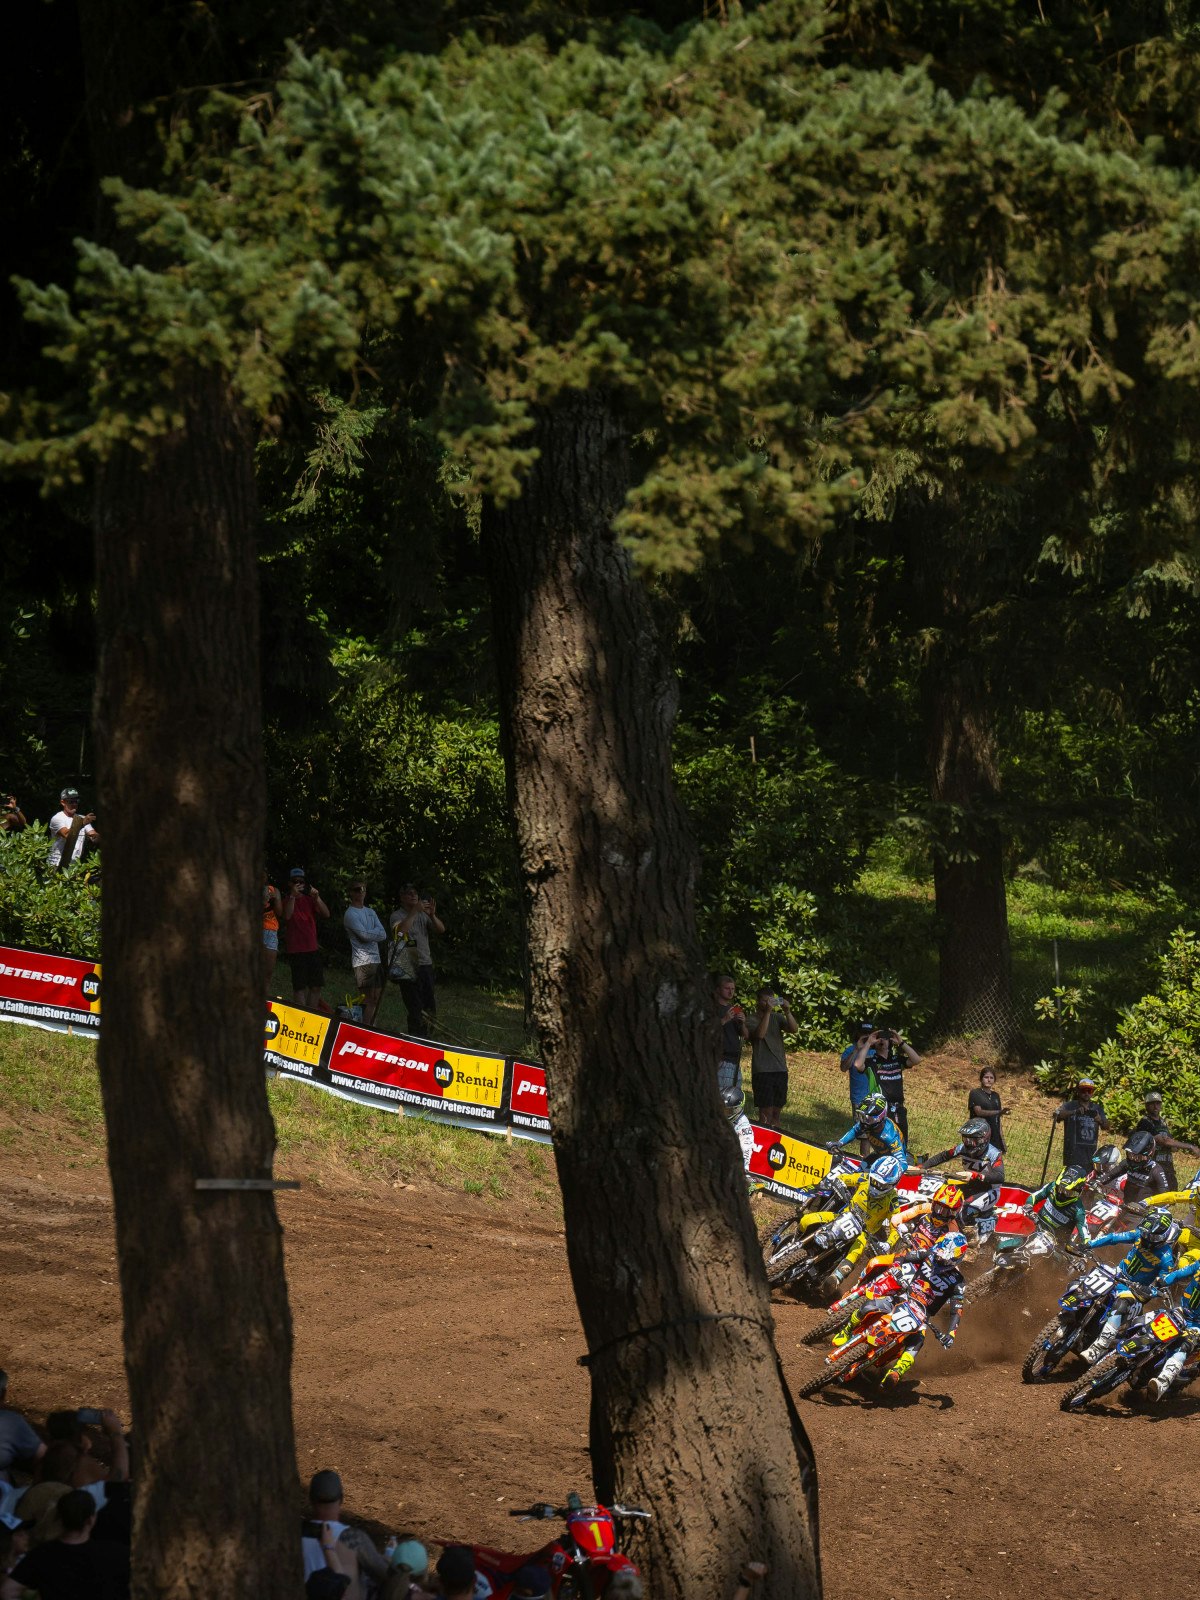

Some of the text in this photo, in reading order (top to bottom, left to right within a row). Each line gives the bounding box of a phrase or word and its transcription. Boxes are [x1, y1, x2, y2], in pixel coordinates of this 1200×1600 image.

[83, 981, 98, 995] CAT
[265, 1020, 277, 1033] AT
[280, 1024, 320, 1047] Rental
[338, 1041, 429, 1072] PETERSON
[435, 1066, 451, 1081] CAT
[455, 1071, 499, 1089] Rental
[331, 1074, 496, 1119] www.CatRentalStore.com/PetersonCat
[769, 1149, 785, 1165] CAT
[787, 1156, 825, 1179] Rental
[838, 1212, 860, 1239] 105
[921, 1261, 949, 1292] THOR
[1084, 1270, 1114, 1294] 511
[891, 1306, 918, 1333] 16
[1151, 1314, 1179, 1341] 38
[589, 1521, 603, 1547] 1
